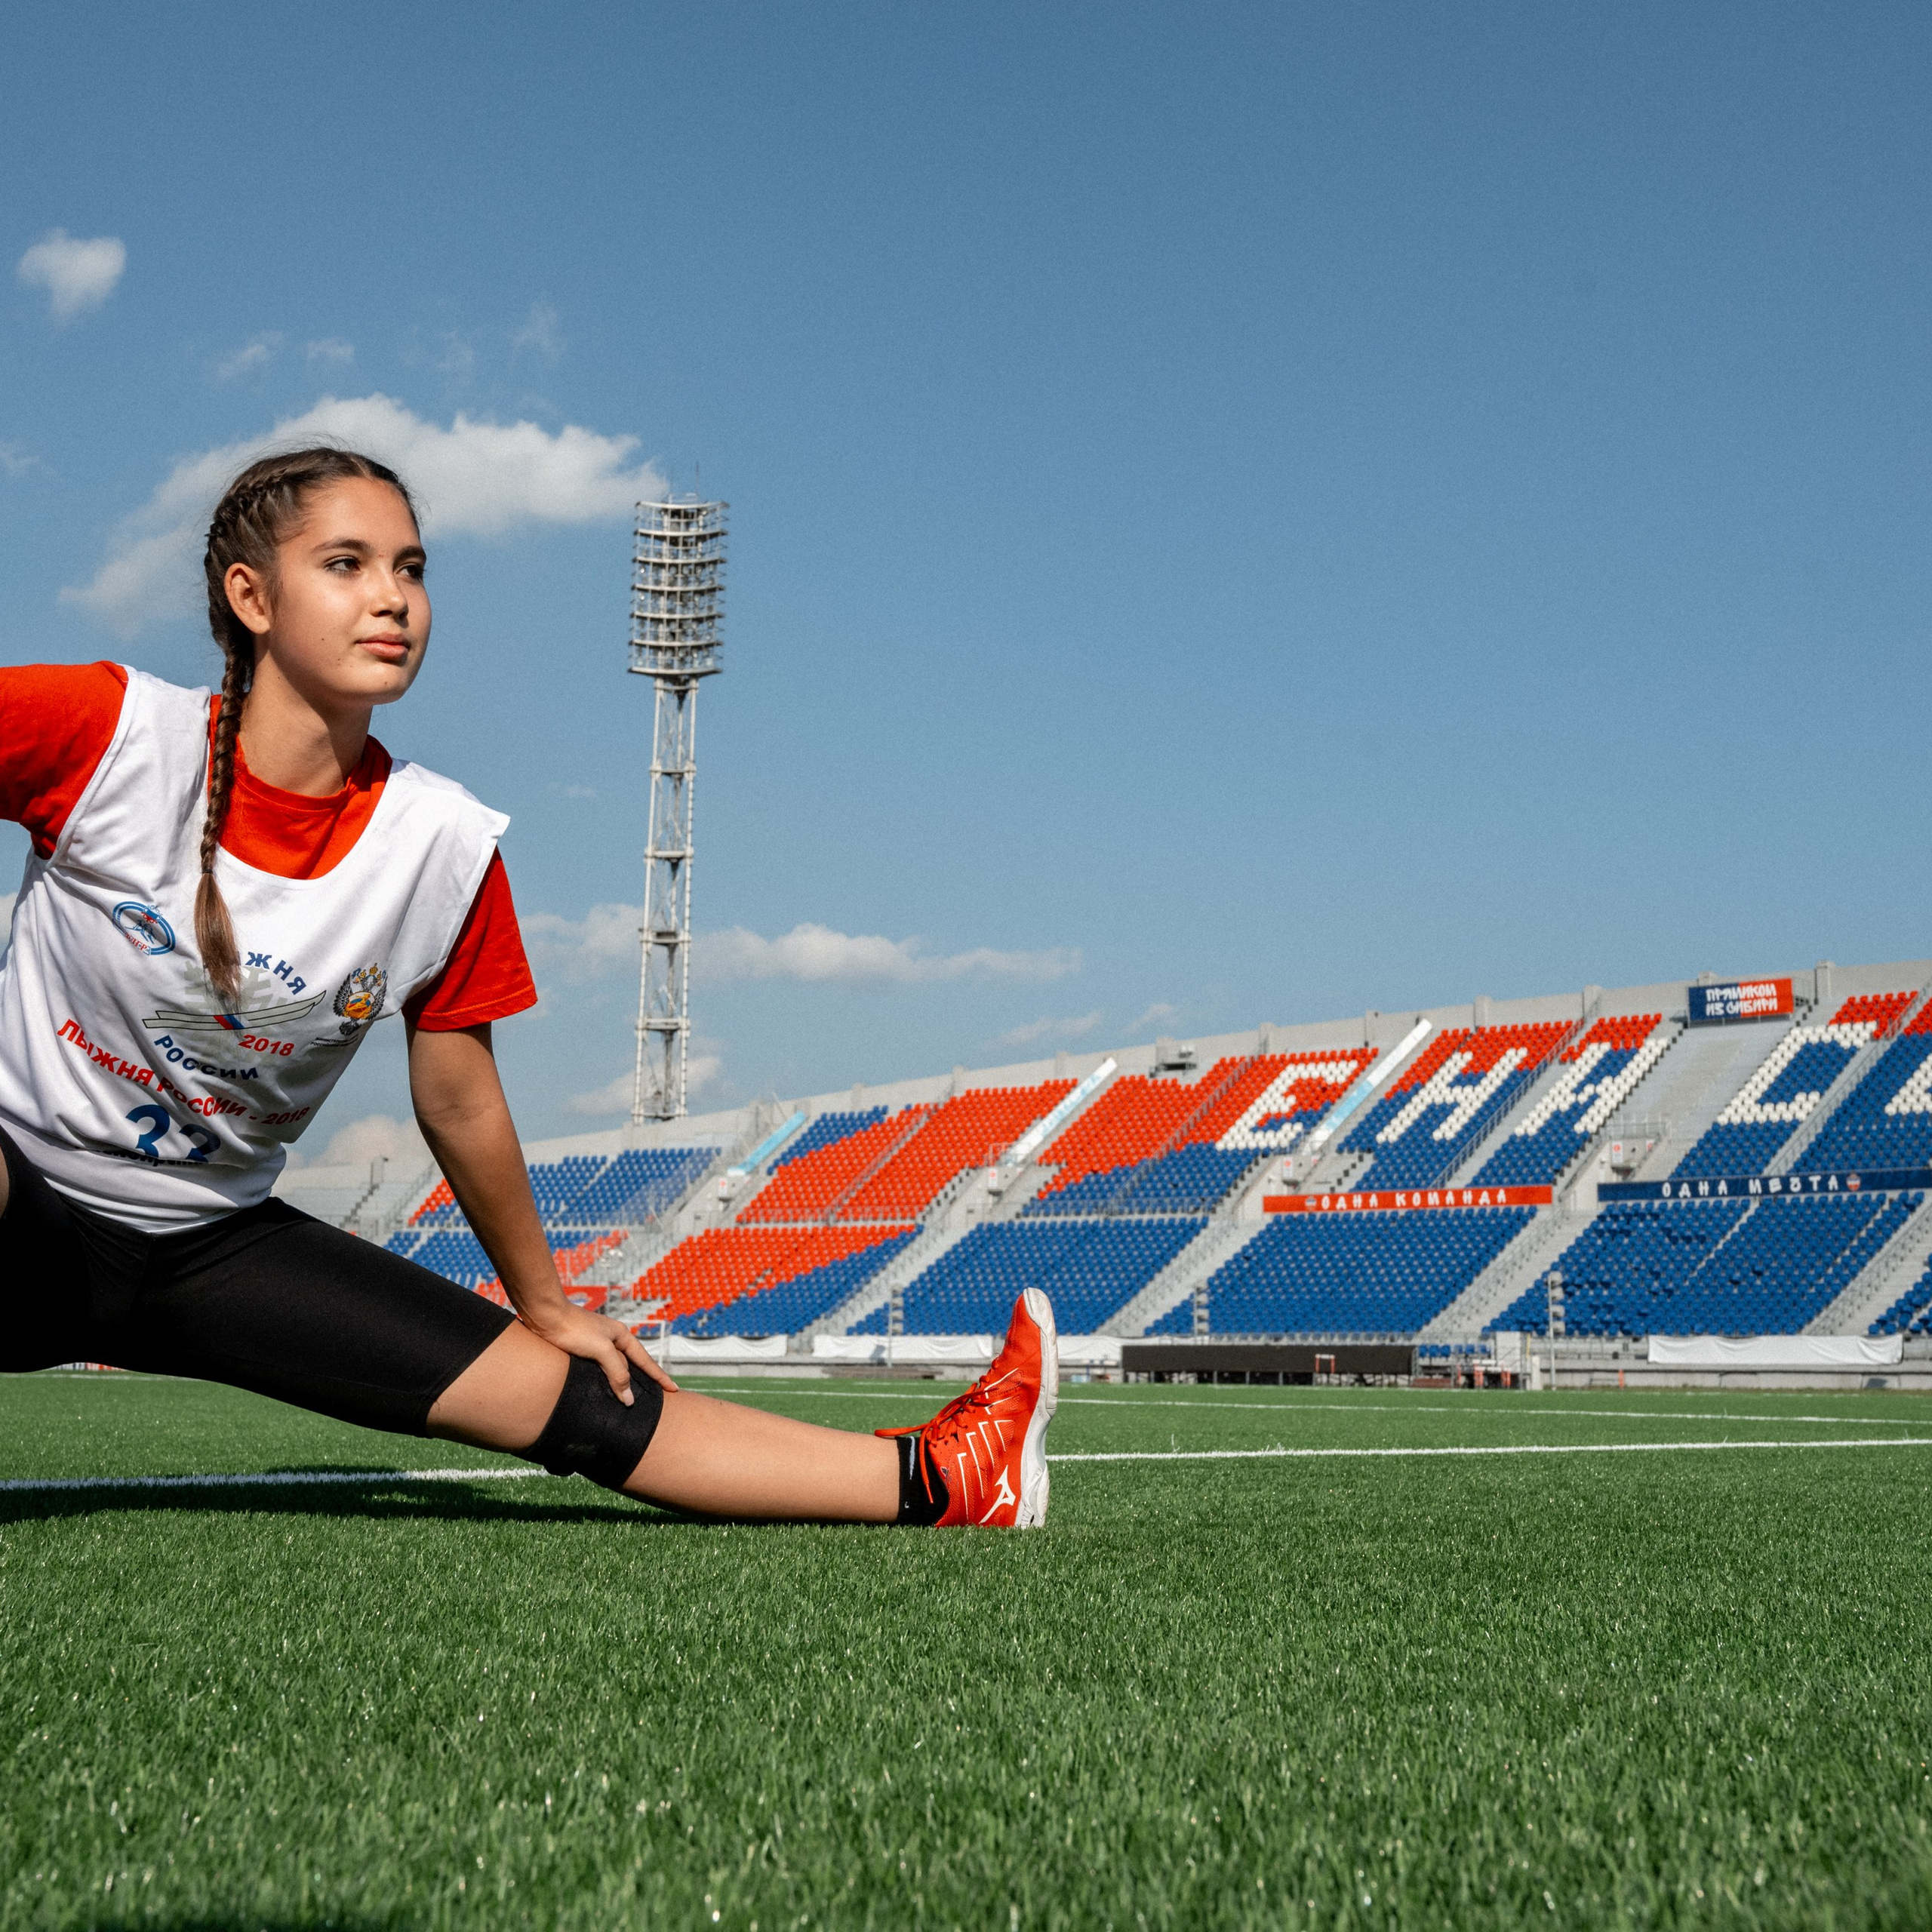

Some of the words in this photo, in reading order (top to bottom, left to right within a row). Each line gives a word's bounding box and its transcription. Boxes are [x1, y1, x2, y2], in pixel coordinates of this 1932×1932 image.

[245, 952, 306, 995] ЖНЯ
[1706, 983, 1777, 1001] ПРЯМИКОМ
[1706, 1001, 1724, 1016] ИЗ
[1726, 998, 1778, 1014] СИБИРИ
[238, 1034, 294, 1056] 2018
[57, 1019, 155, 1086] ЛЫЖНЯ
[156, 1077, 248, 1117] РОССИИ
[154, 1035, 258, 1080] РОССИИ
[1662, 1179, 1728, 1198] ОДНА
[1321, 1193, 1378, 1211] ОДНА
[1395, 1189, 1506, 1206] КОМАНДА
